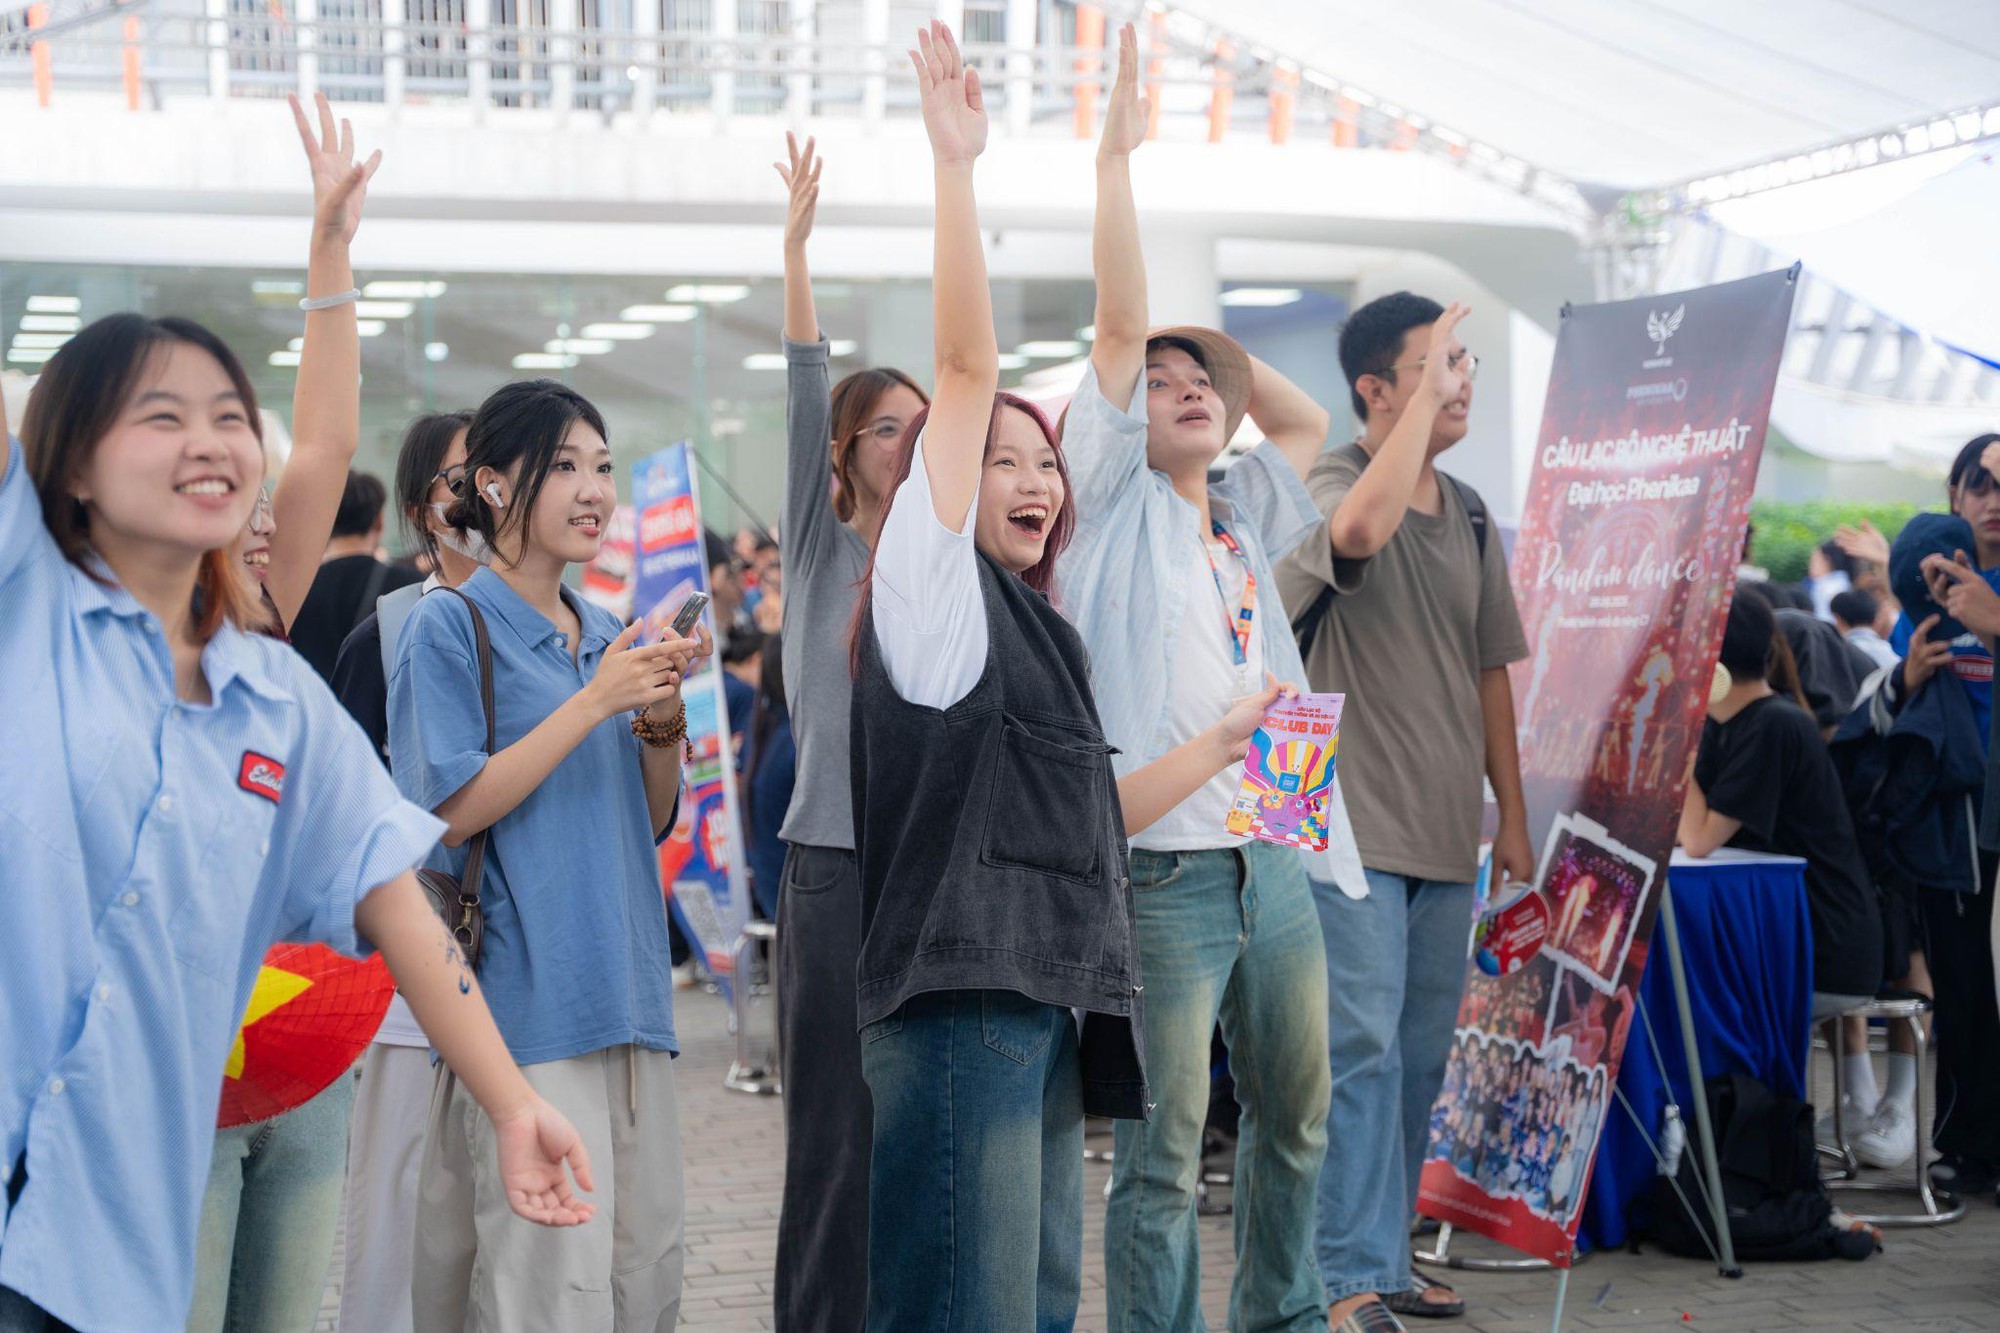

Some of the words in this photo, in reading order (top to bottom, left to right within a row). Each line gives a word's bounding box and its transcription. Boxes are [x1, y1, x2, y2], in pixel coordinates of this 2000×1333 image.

[1541, 435, 1582, 469] CÂU
[1643, 423, 1692, 465] NGHỆ
[1691, 417, 1752, 461] THUẬT
[1627, 541, 1705, 590] dance
[1265, 716, 1308, 733] CLUB
[1312, 722, 1334, 736] DAY
